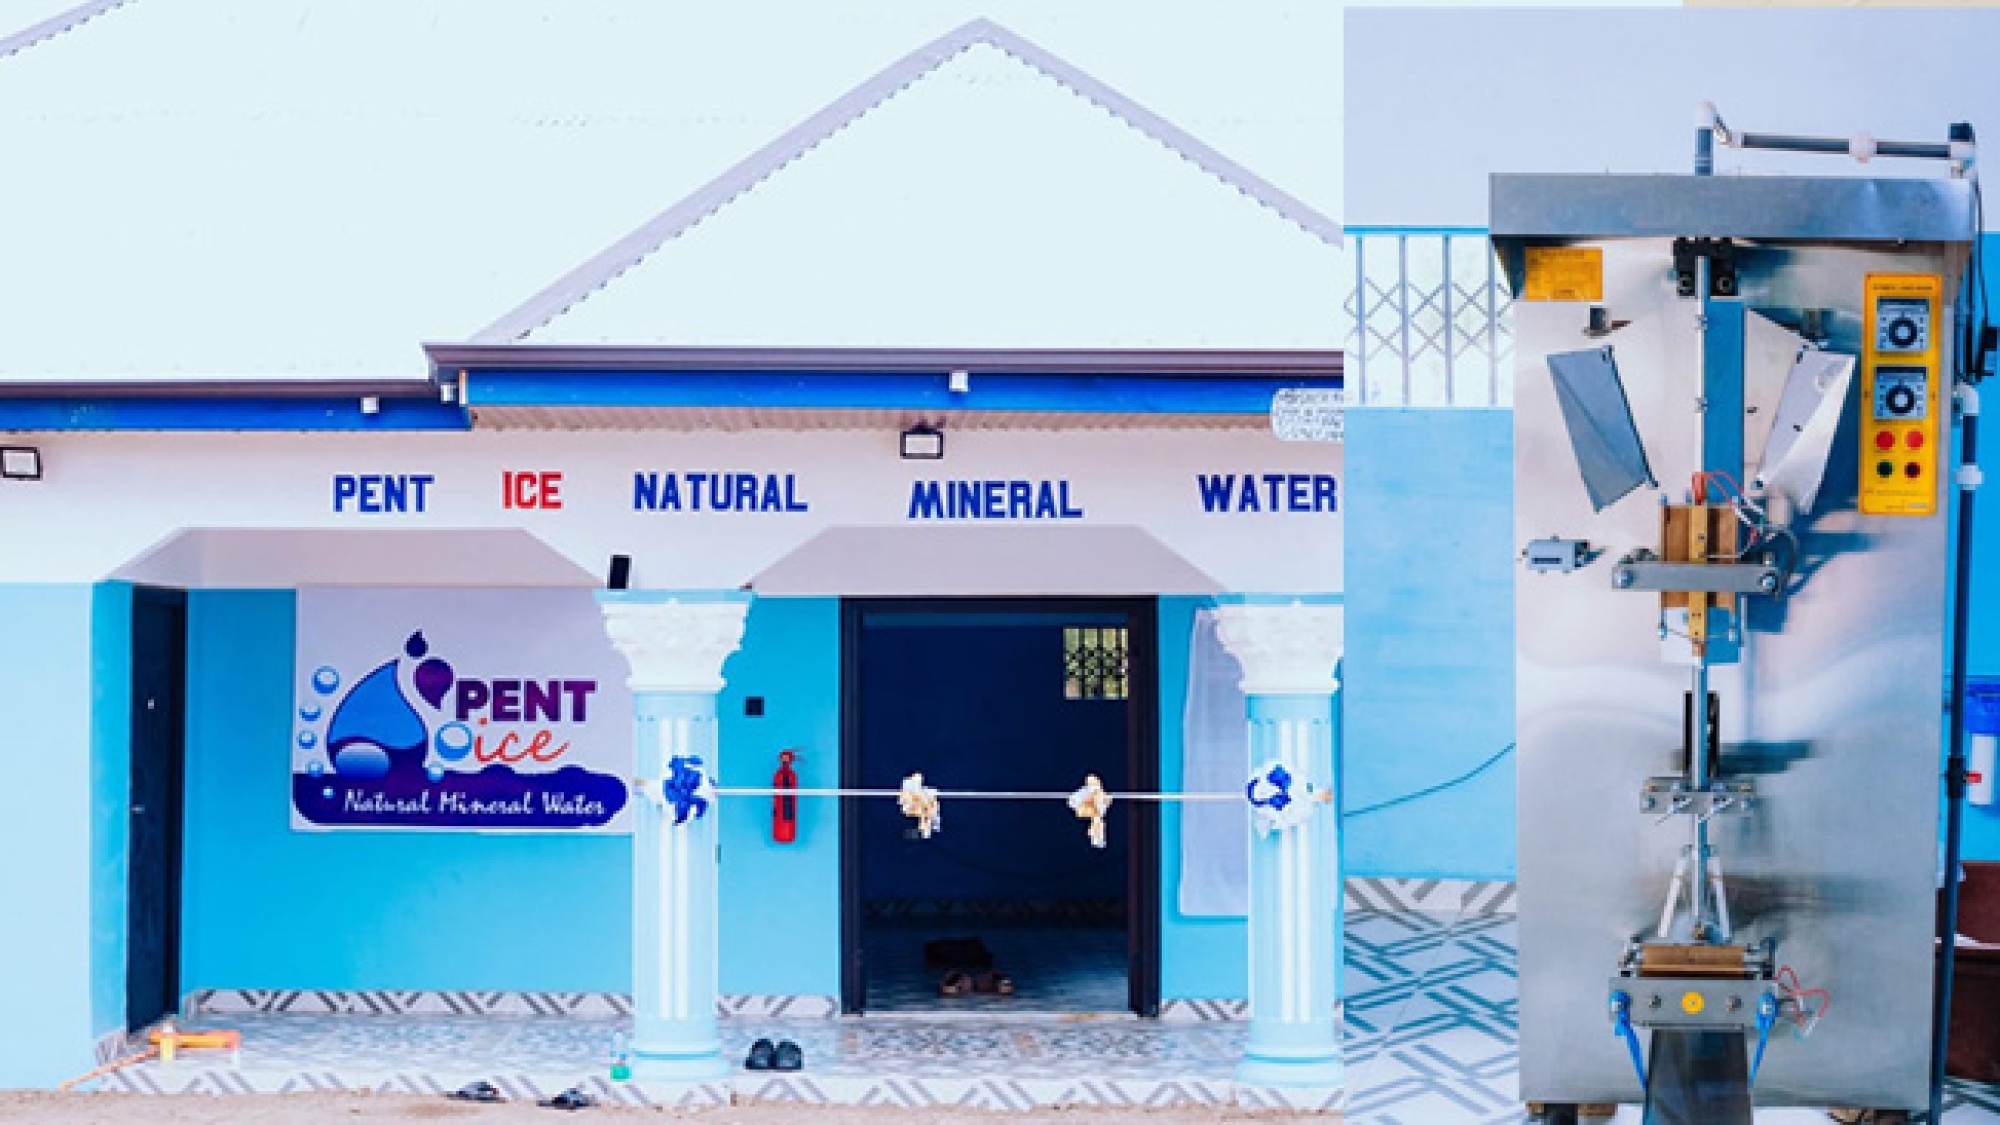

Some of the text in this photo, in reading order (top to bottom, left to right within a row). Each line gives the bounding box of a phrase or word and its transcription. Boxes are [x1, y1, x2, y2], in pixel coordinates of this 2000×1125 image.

[333, 471, 1338, 519] PENT ICE NATURAL MINERAL WATER
[455, 679, 598, 723] PENT
[473, 717, 570, 764] ice
[343, 788, 605, 816] Natural Mineral Water
